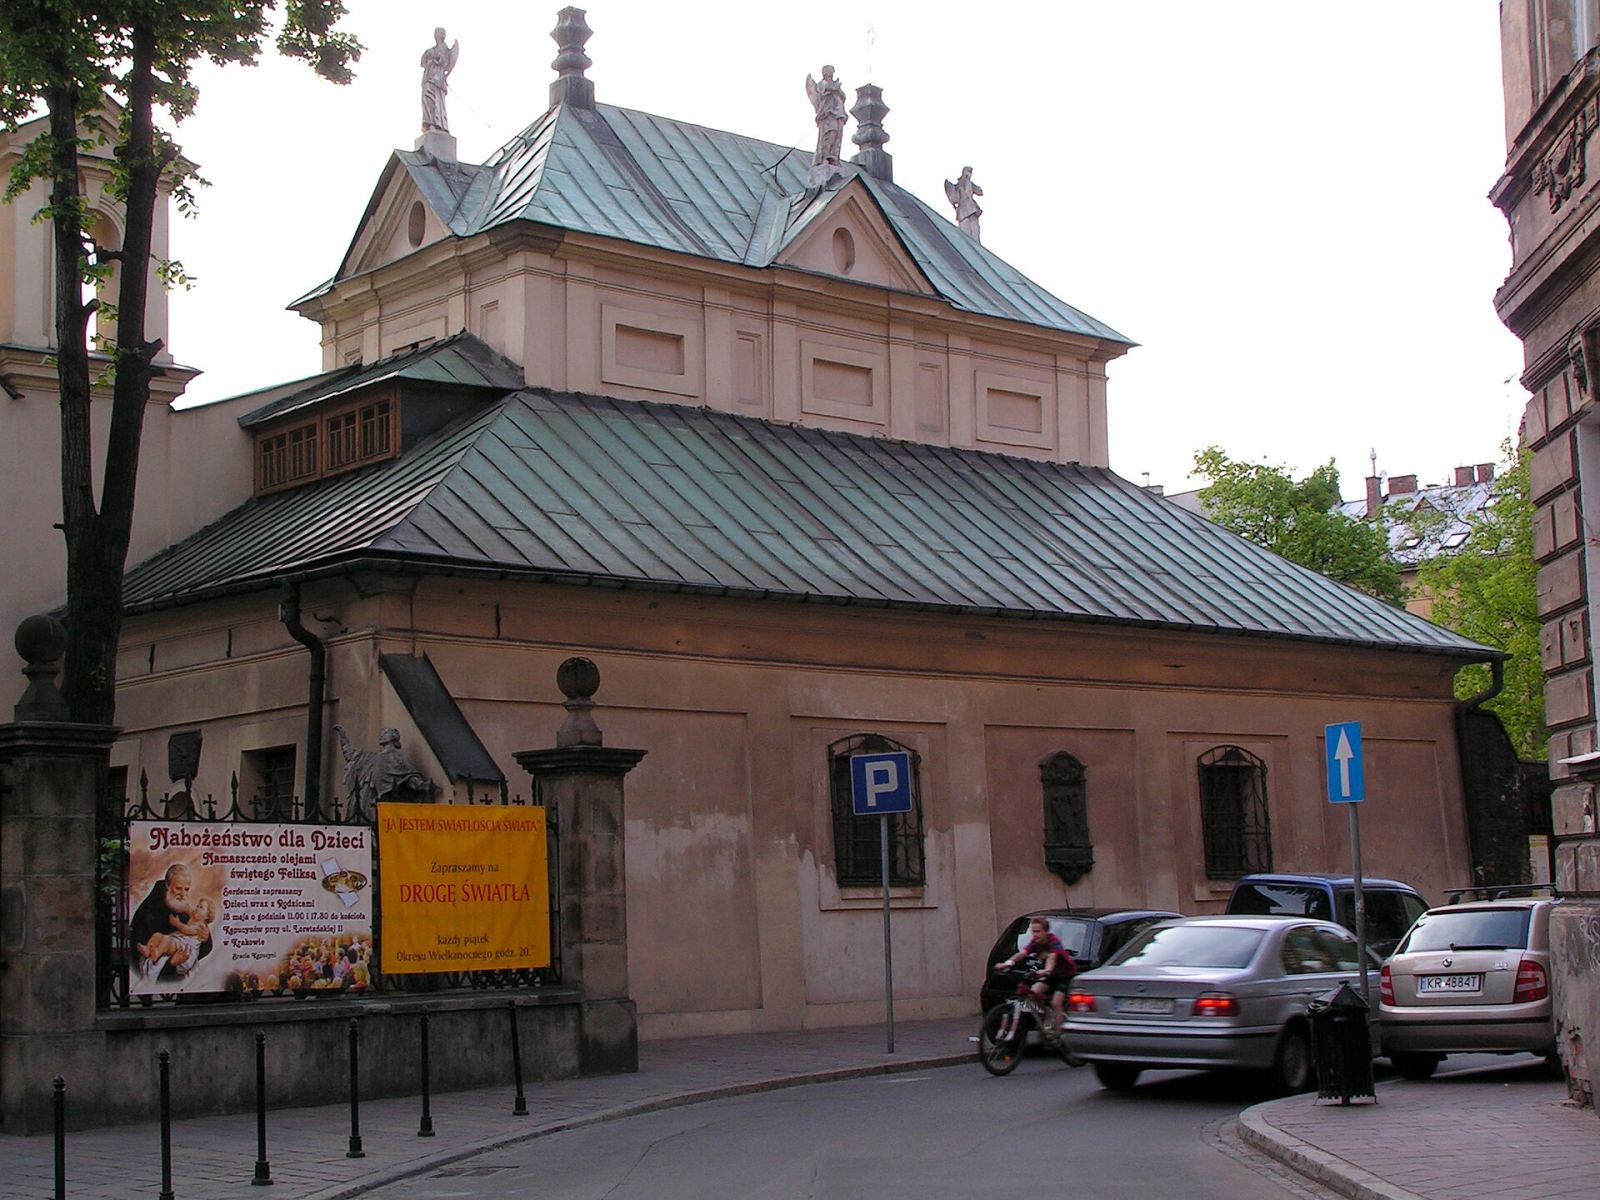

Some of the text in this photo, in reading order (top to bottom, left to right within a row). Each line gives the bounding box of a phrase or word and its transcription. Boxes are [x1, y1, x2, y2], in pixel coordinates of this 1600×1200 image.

[865, 760, 898, 807] P
[399, 817, 435, 834] JESTEM
[149, 826, 365, 851] Nabożeństwo dla Dzieci
[202, 851, 317, 866] Namaszczenie olejami
[230, 867, 275, 881] świętego
[488, 864, 499, 873] na
[222, 887, 303, 897] Serdecznie zapraszamy
[400, 879, 531, 906] DROGĘ ŚWIATŁA
[222, 899, 248, 910] Dzieci
[277, 899, 315, 910] Rodzicami
[232, 912, 250, 922] maja
[257, 912, 285, 922] godzinie
[330, 912, 339, 920] do
[340, 911, 366, 920] kościoła
[265, 925, 280, 934] przy
[282, 925, 291, 933] ul.
[292, 924, 336, 935] Loretańskiej
[231, 938, 265, 949] Krakowie
[437, 933, 490, 946] każdy piątek
[396, 950, 427, 961] Okresu
[428, 949, 493, 961] Wielkanocnego
[1428, 976, 1477, 989] KR 4884T
